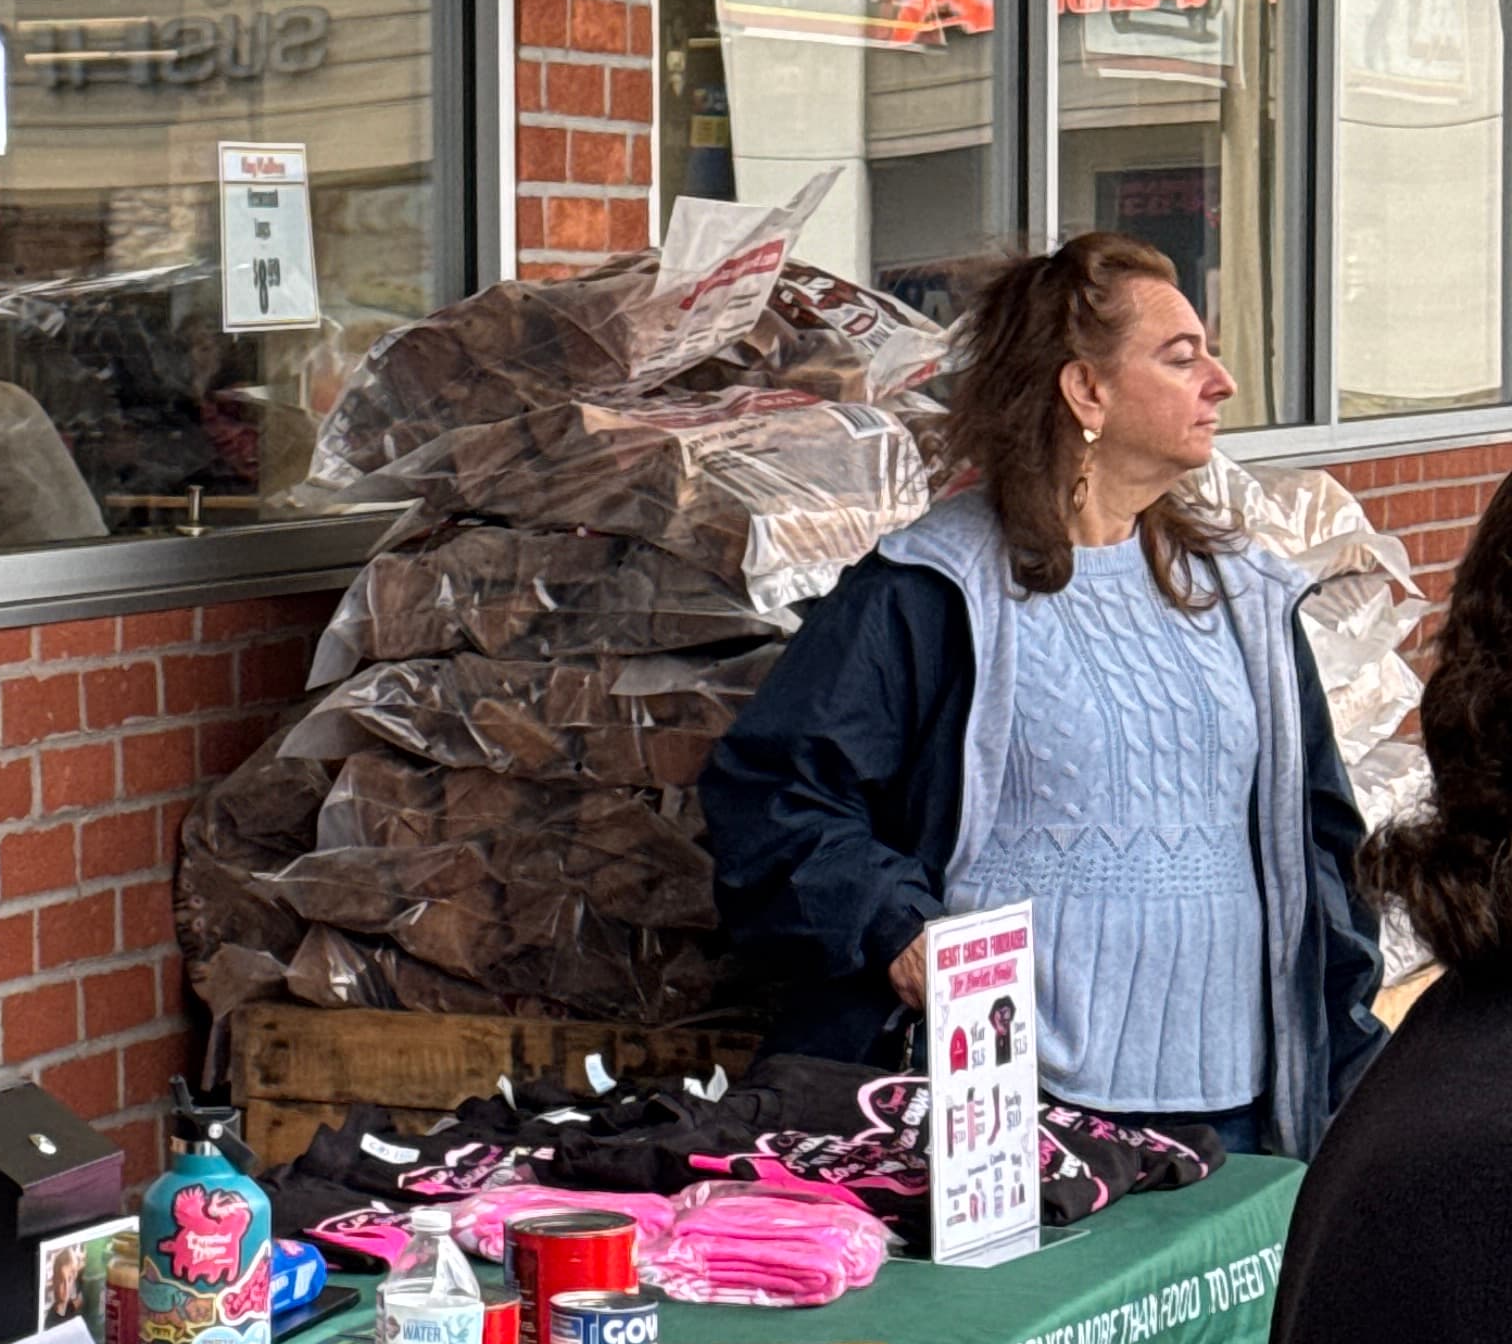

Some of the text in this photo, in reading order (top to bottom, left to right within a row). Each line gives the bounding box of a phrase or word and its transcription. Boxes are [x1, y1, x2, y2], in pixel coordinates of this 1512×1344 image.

[1159, 1276, 1200, 1333] FOOD
[1203, 1266, 1230, 1314] TO
[1229, 1254, 1265, 1305] FEED
[402, 1325, 442, 1344] WATER
